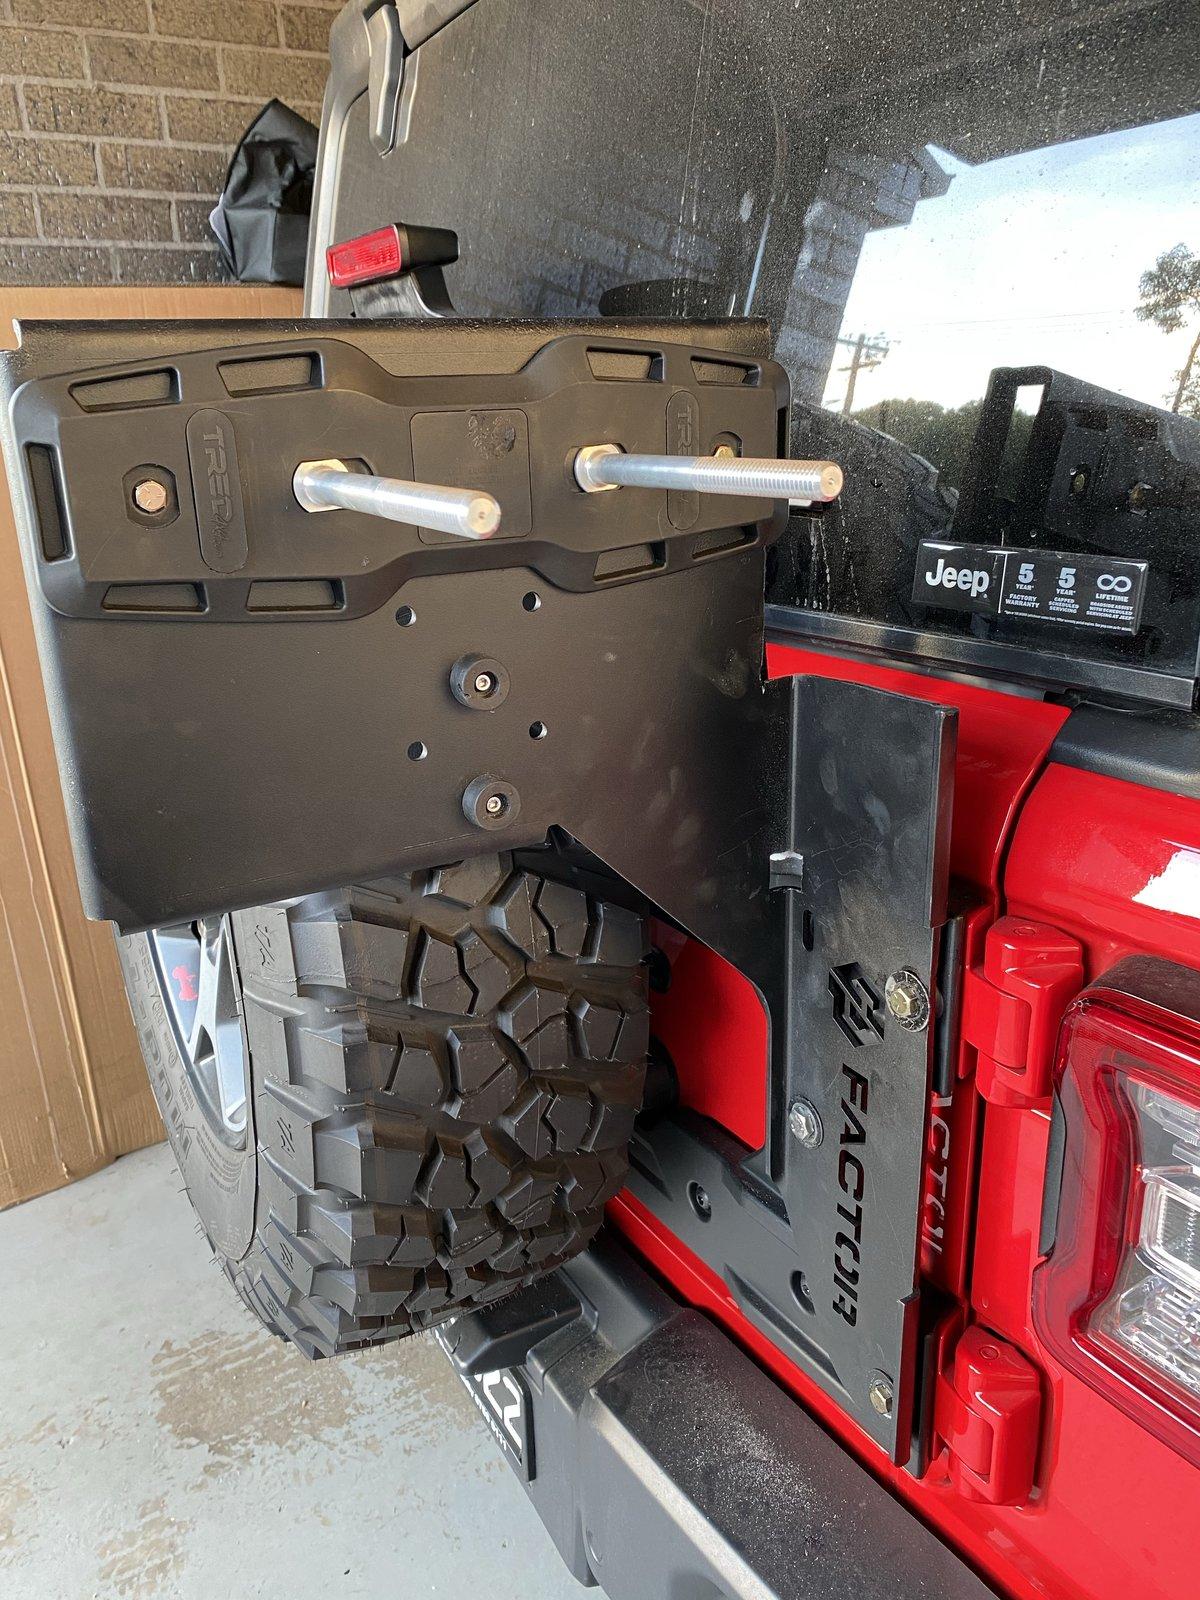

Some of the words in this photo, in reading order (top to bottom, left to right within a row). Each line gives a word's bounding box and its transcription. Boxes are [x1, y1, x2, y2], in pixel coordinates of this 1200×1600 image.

[203, 424, 232, 522] TRED
[1018, 563, 1035, 584] 5
[1058, 567, 1077, 589] 5
[1009, 593, 1038, 602] FACTORY
[1095, 593, 1129, 603] LIFETIME
[1005, 598, 1040, 608] WARRANTY
[1048, 600, 1080, 609] SCHEDULED
[1049, 605, 1077, 614] SERVICING
[832, 1062, 869, 1327] FACTOR
